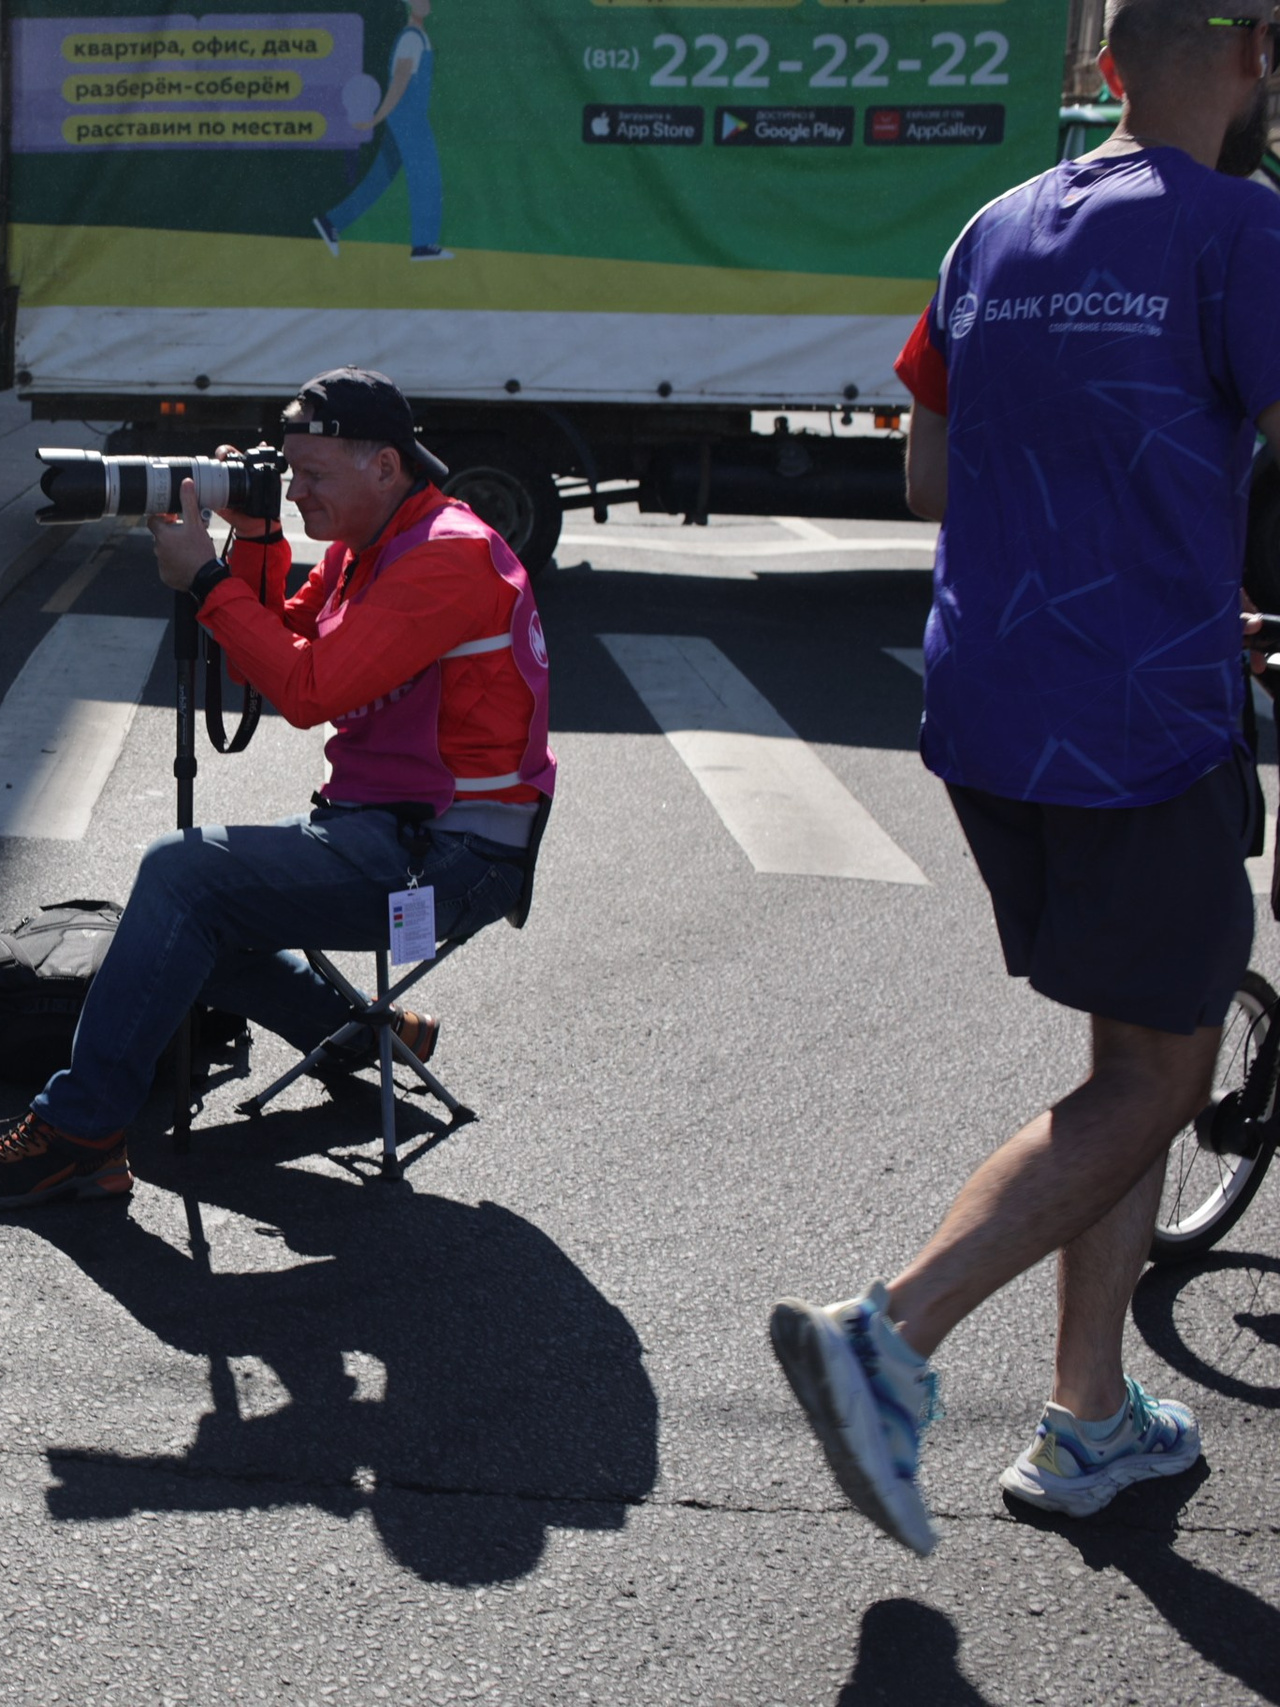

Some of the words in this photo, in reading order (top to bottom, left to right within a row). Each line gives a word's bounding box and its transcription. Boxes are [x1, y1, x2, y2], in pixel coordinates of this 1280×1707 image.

[73, 36, 185, 60] квартира,
[192, 35, 256, 58] офис,
[262, 37, 317, 56] дача
[583, 47, 639, 71] (812)
[650, 31, 1009, 88] 222-22-22
[75, 76, 290, 100] разберём-соберём
[76, 121, 191, 142] расставим
[199, 121, 225, 136] по
[232, 120, 313, 136] местам
[616, 121, 650, 140] App
[652, 121, 696, 138] Store
[754, 121, 810, 142] Google
[813, 122, 846, 142] Play
[907, 122, 987, 141] AppGallery
[984, 296, 1045, 322] БАНК
[1049, 292, 1169, 321] РОССИЯ
